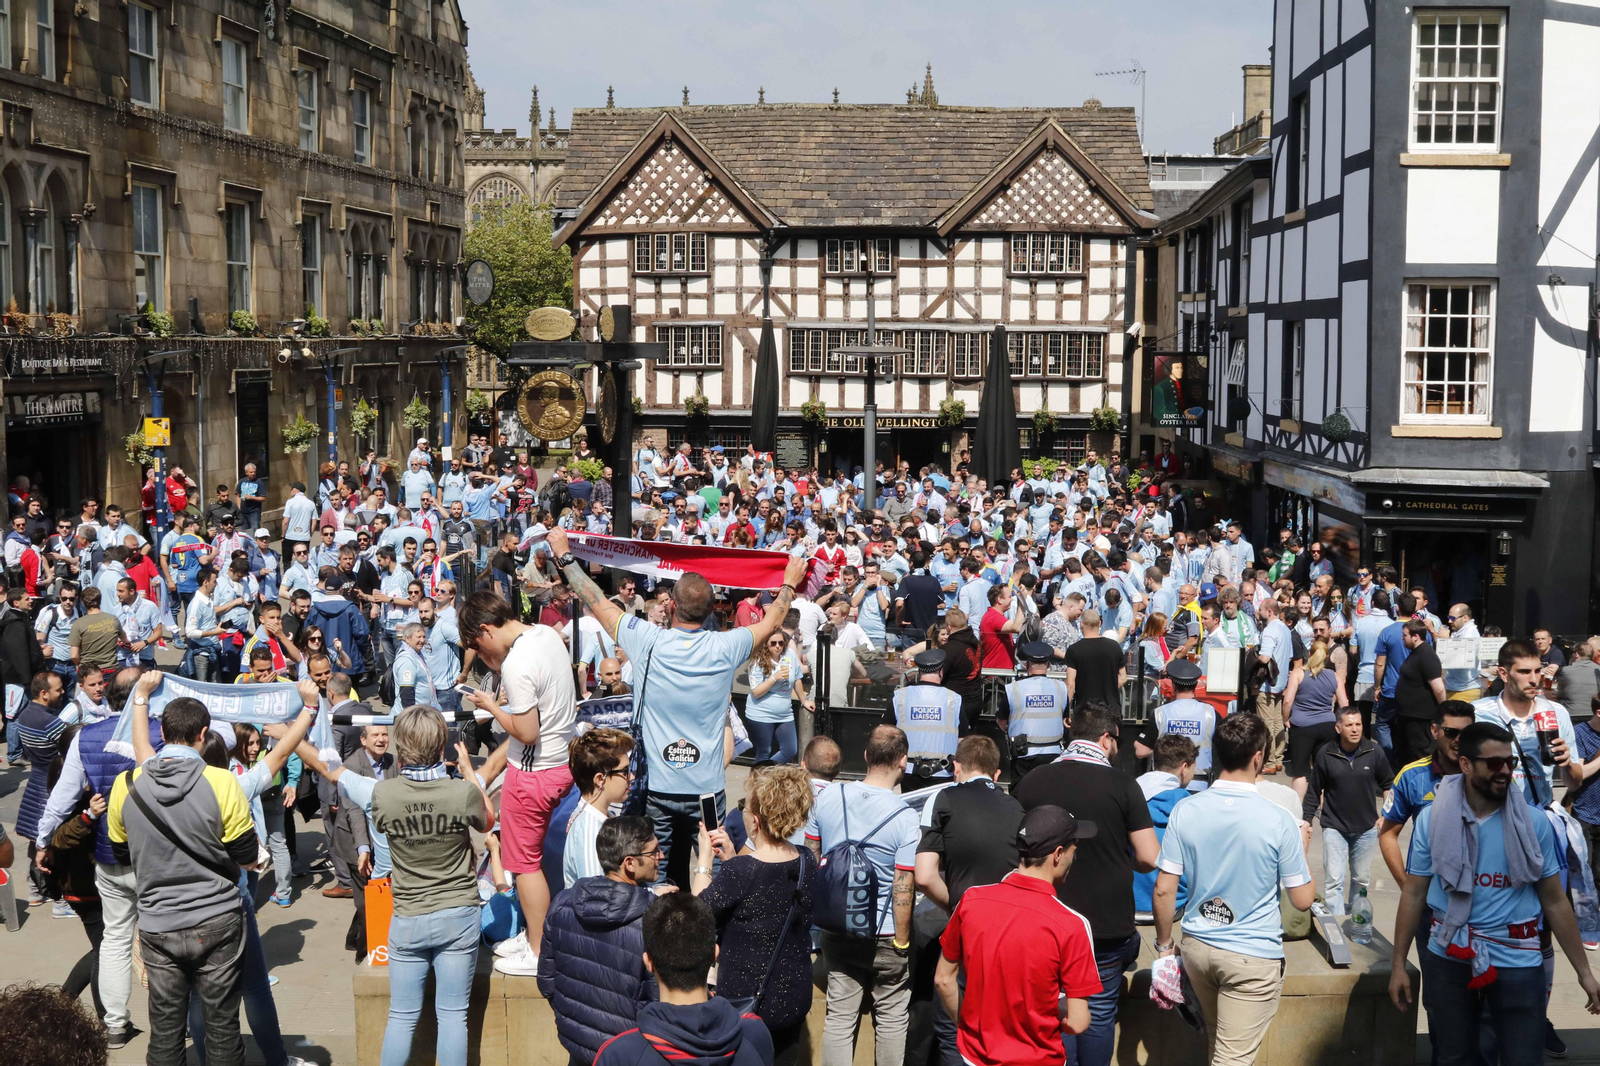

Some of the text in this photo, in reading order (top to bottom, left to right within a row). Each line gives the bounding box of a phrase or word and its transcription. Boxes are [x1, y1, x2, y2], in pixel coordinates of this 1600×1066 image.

[541, 372, 561, 380] THE
[25, 398, 84, 415] THE MITRE
[26, 416, 84, 424] MANCHESTER
[518, 404, 530, 425] OLD
[531, 404, 585, 440] WELLINGTON
[816, 418, 839, 427] THE
[254, 690, 290, 718] RC
[668, 746, 696, 755] Estrella
[668, 754, 694, 762] Galicia
[376, 813, 467, 839] LONDON
[1202, 903, 1231, 916] Estrella
[1204, 910, 1230, 924] Galicia
